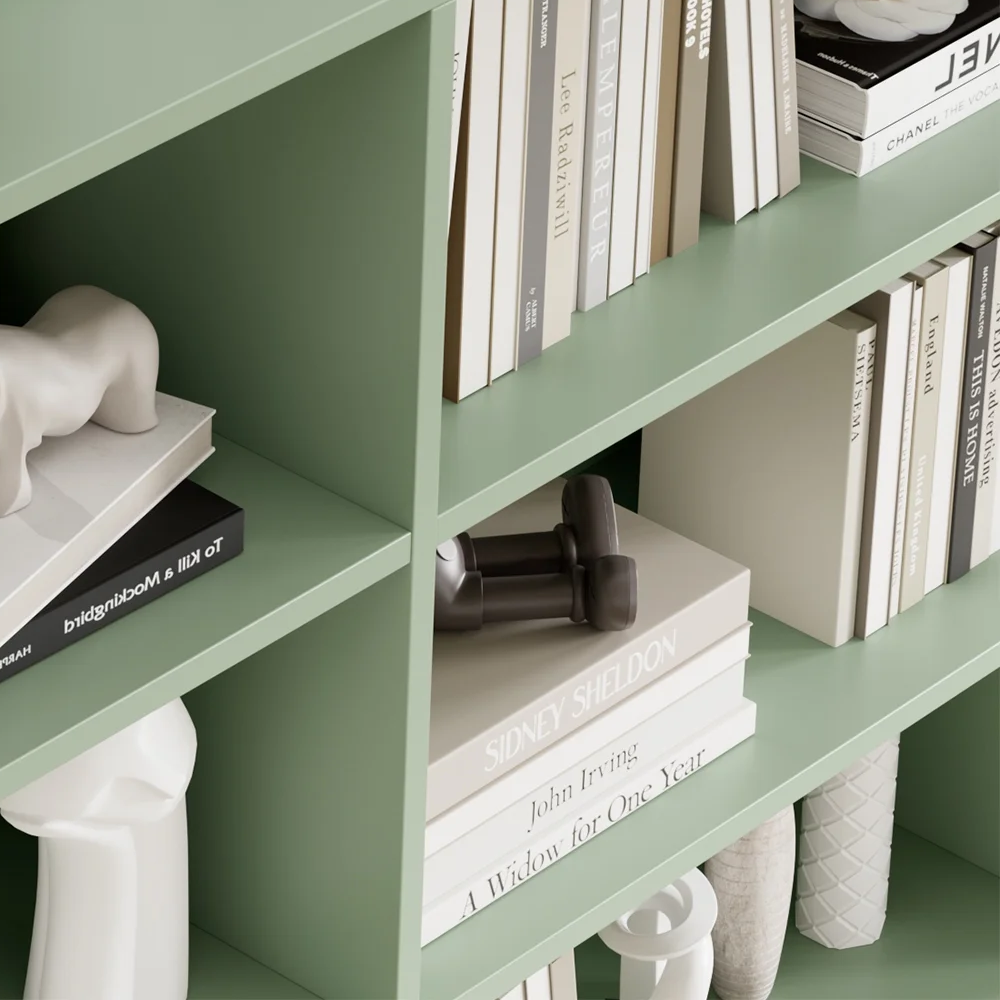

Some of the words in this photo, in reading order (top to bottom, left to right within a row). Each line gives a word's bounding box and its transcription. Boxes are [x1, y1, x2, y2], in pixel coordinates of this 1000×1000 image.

[684, 35, 696, 49] 9
[559, 68, 577, 114] Lee
[886, 115, 940, 151] CHANEL
[943, 100, 966, 120] THE
[553, 122, 575, 240] Radziwill
[981, 265, 989, 302] NATALIE
[977, 301, 986, 340] WALTON
[866, 339, 876, 391] PAUL
[923, 314, 939, 395] England
[971, 348, 985, 398] THIS
[851, 343, 866, 442] SIETSEMA
[968, 402, 980, 421] IS
[963, 423, 979, 487] HOME
[979, 388, 998, 489] advertising
[915, 454, 927, 507] United
[909, 509, 922, 577] Kingdom
[483, 697, 566, 773] SIDNEY
[571, 628, 679, 720] SHELDON
[526, 783, 574, 834] John
[580, 741, 640, 793] Irving
[458, 890, 478, 920] A
[487, 838, 565, 900] Widow
[570, 811, 602, 849] for
[606, 783, 653, 824] One
[659, 748, 707, 792] Year
